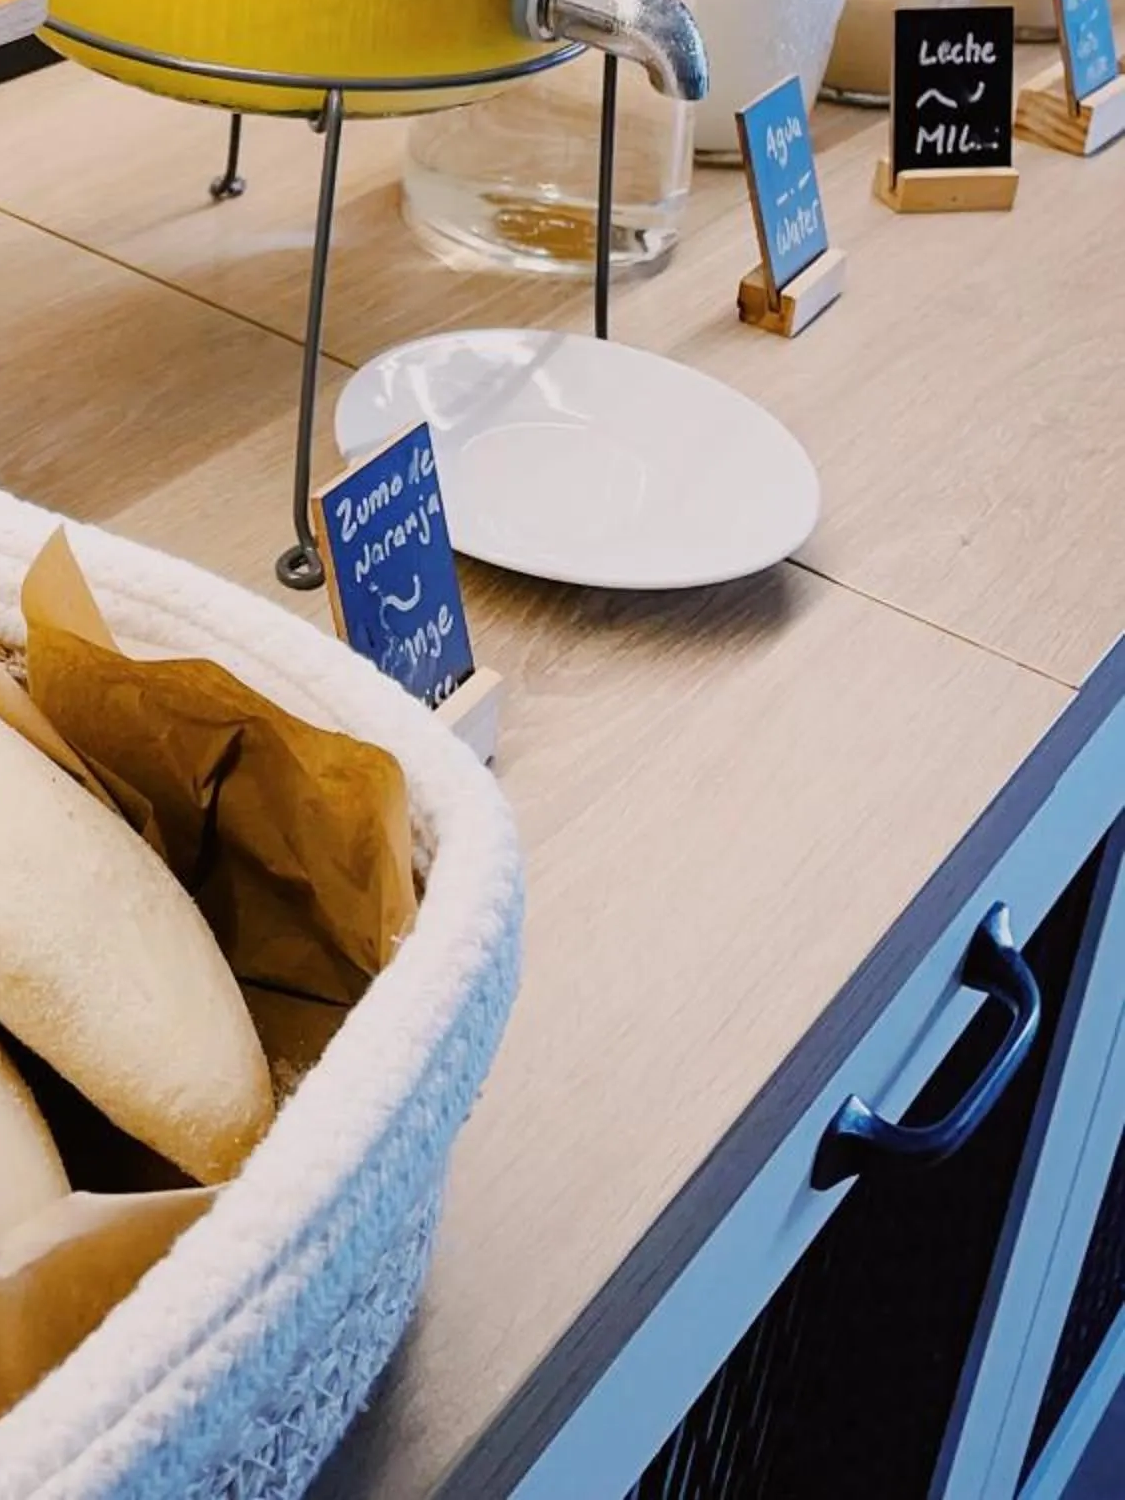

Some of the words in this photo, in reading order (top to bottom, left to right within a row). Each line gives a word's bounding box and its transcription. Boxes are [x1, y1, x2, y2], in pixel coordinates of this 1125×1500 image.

[918, 31, 997, 66] Leche
[765, 115, 803, 168] Agua
[915, 123, 999, 155] MIL
[335, 477, 404, 543] Zumo
[407, 447, 435, 487] de
[354, 491, 441, 583] Naranja
